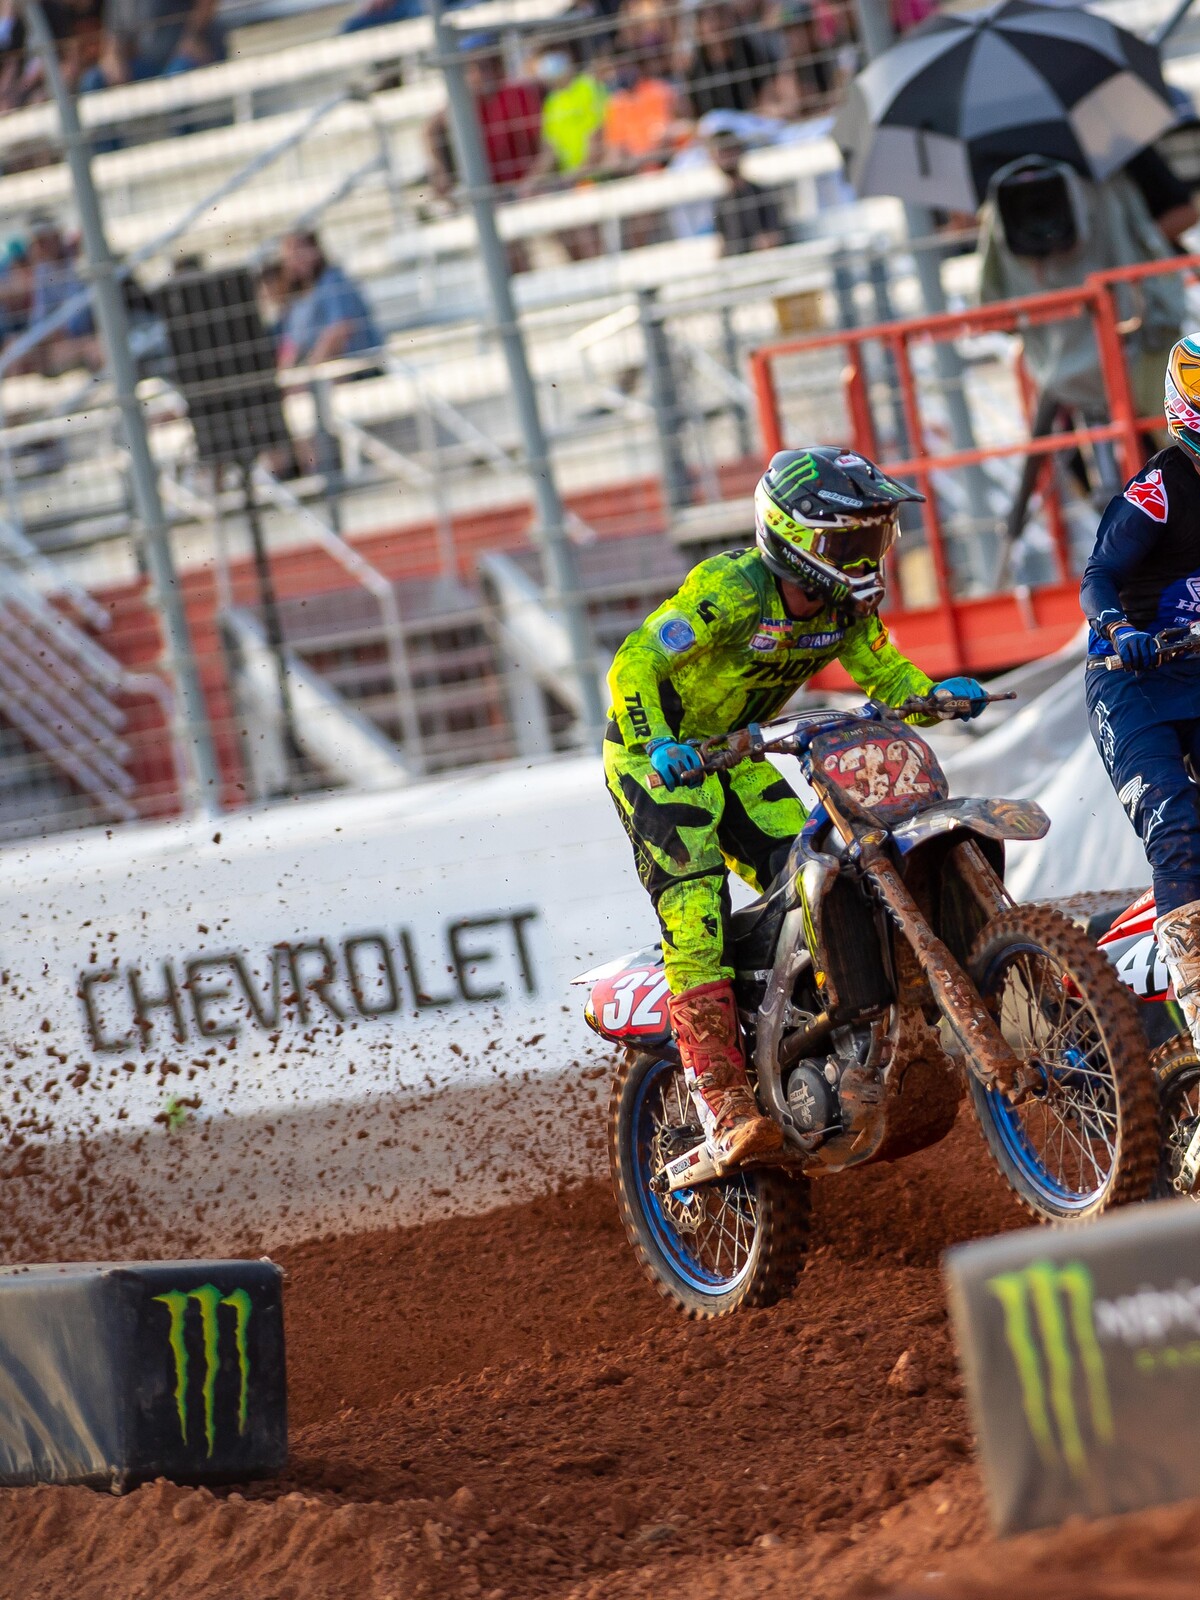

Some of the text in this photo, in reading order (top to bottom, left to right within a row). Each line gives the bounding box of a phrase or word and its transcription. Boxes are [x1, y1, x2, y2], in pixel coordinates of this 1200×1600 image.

[781, 546, 831, 587] MONSTER
[625, 692, 652, 739] THOR
[839, 740, 932, 808] 32
[76, 904, 541, 1054] CHEVROLET
[602, 970, 670, 1031] 32
